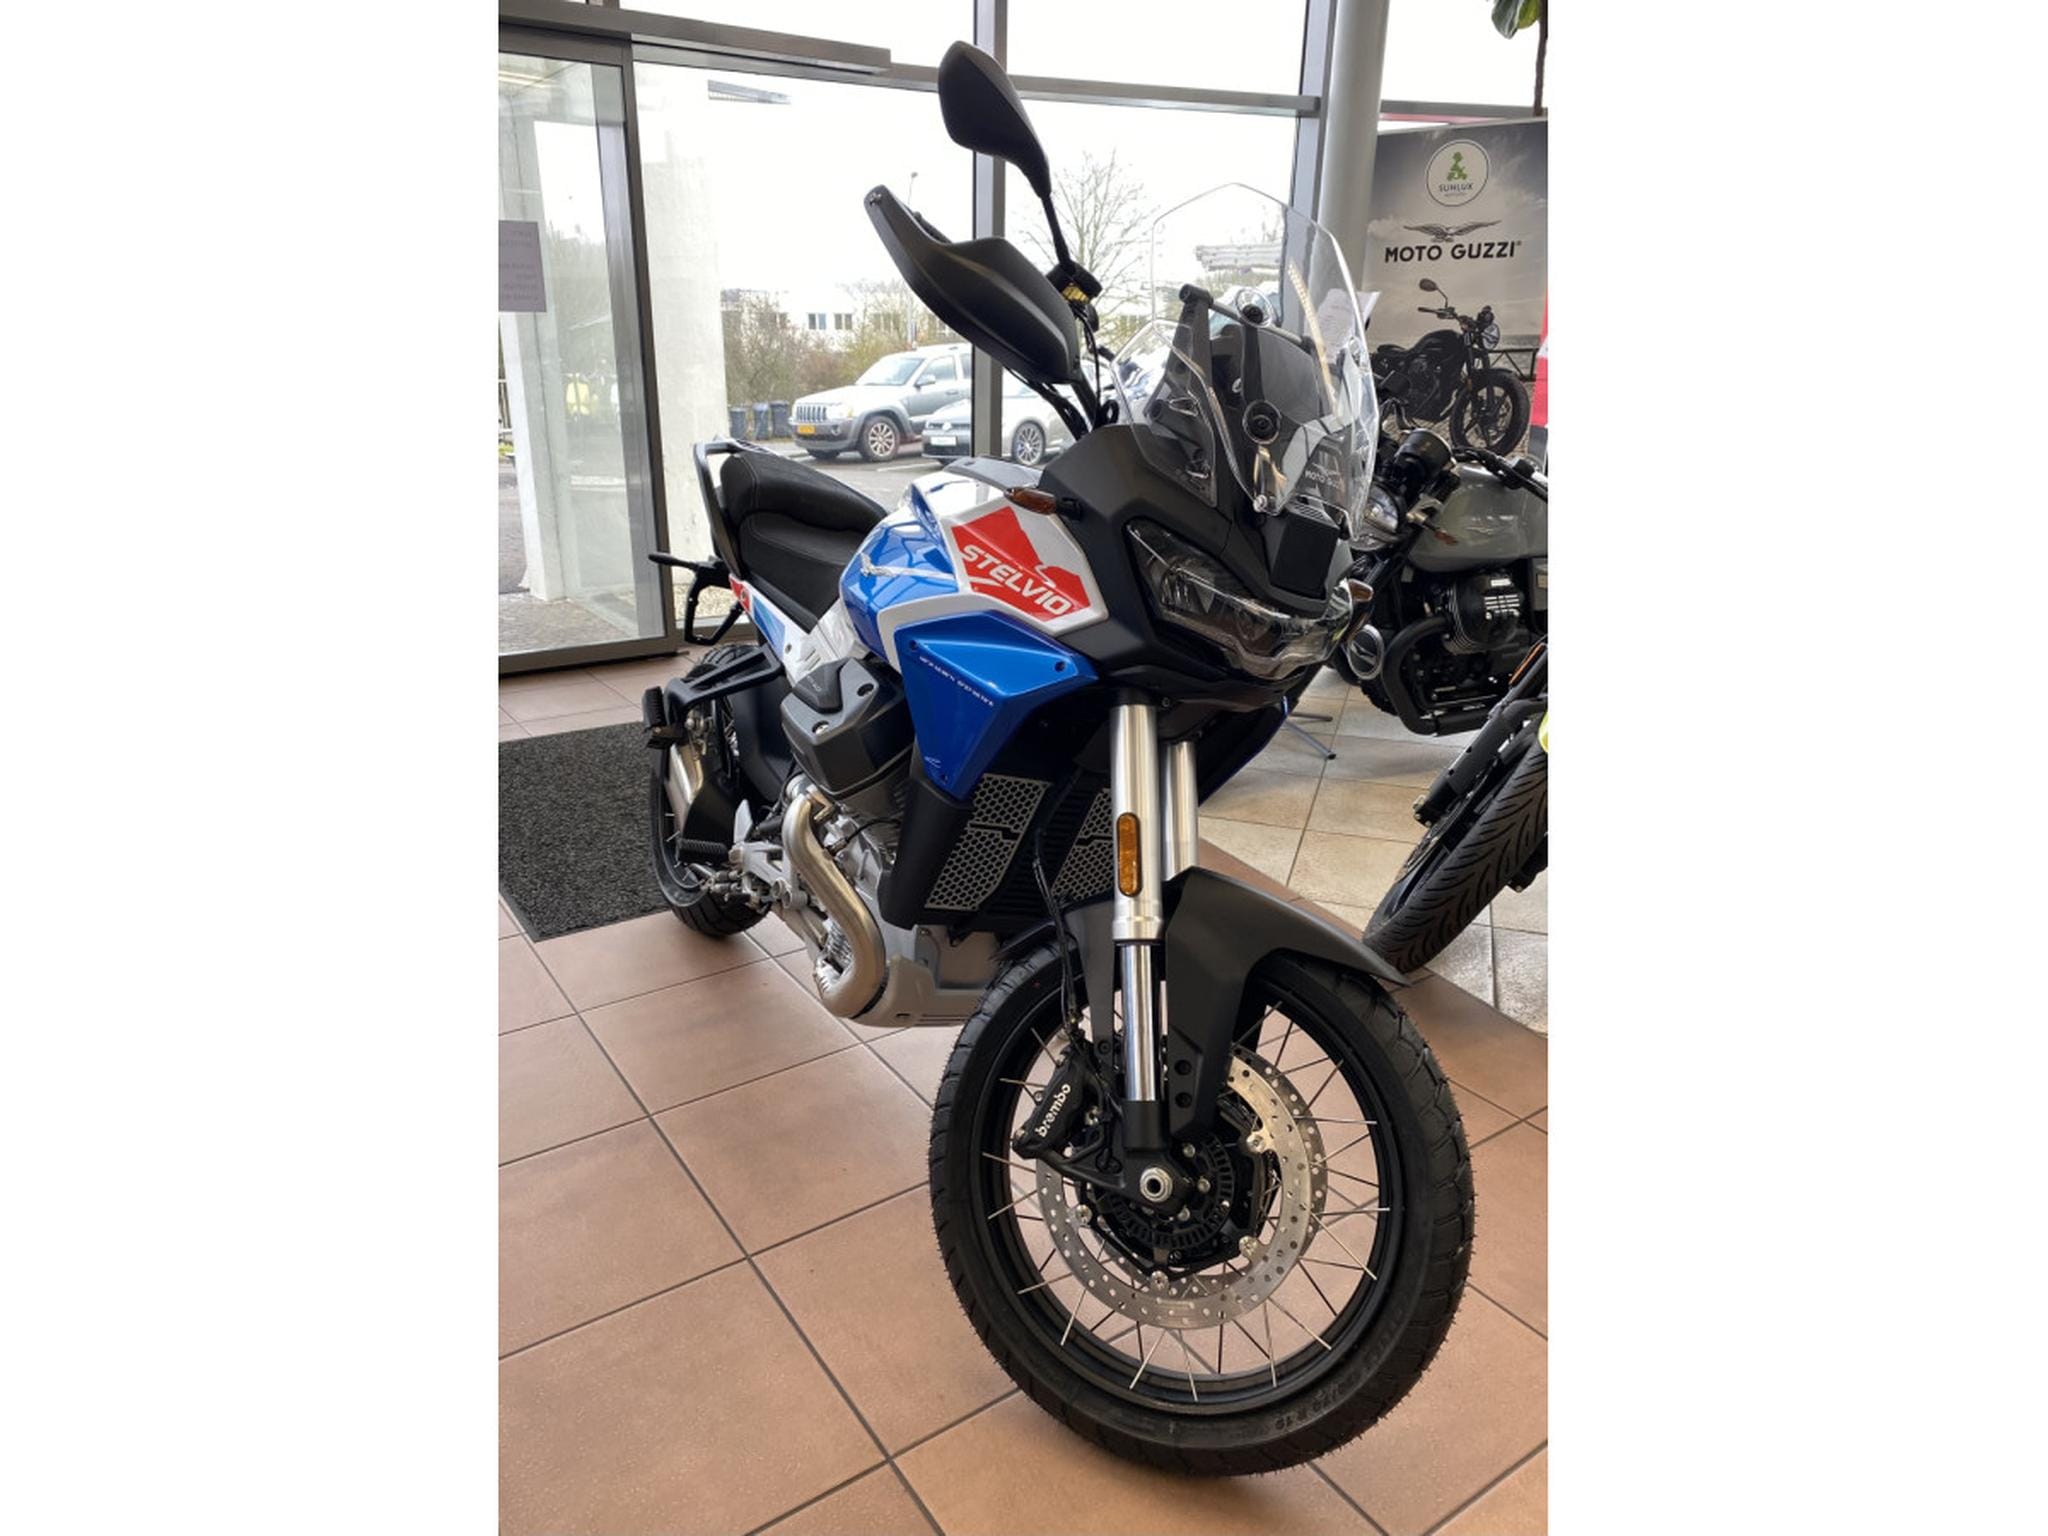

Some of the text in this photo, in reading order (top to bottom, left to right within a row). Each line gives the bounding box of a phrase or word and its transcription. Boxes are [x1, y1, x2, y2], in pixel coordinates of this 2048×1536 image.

[1384, 245, 1442, 263] MOTO
[960, 544, 1072, 615] STELVIO
[1034, 1083, 1071, 1138] brembo
